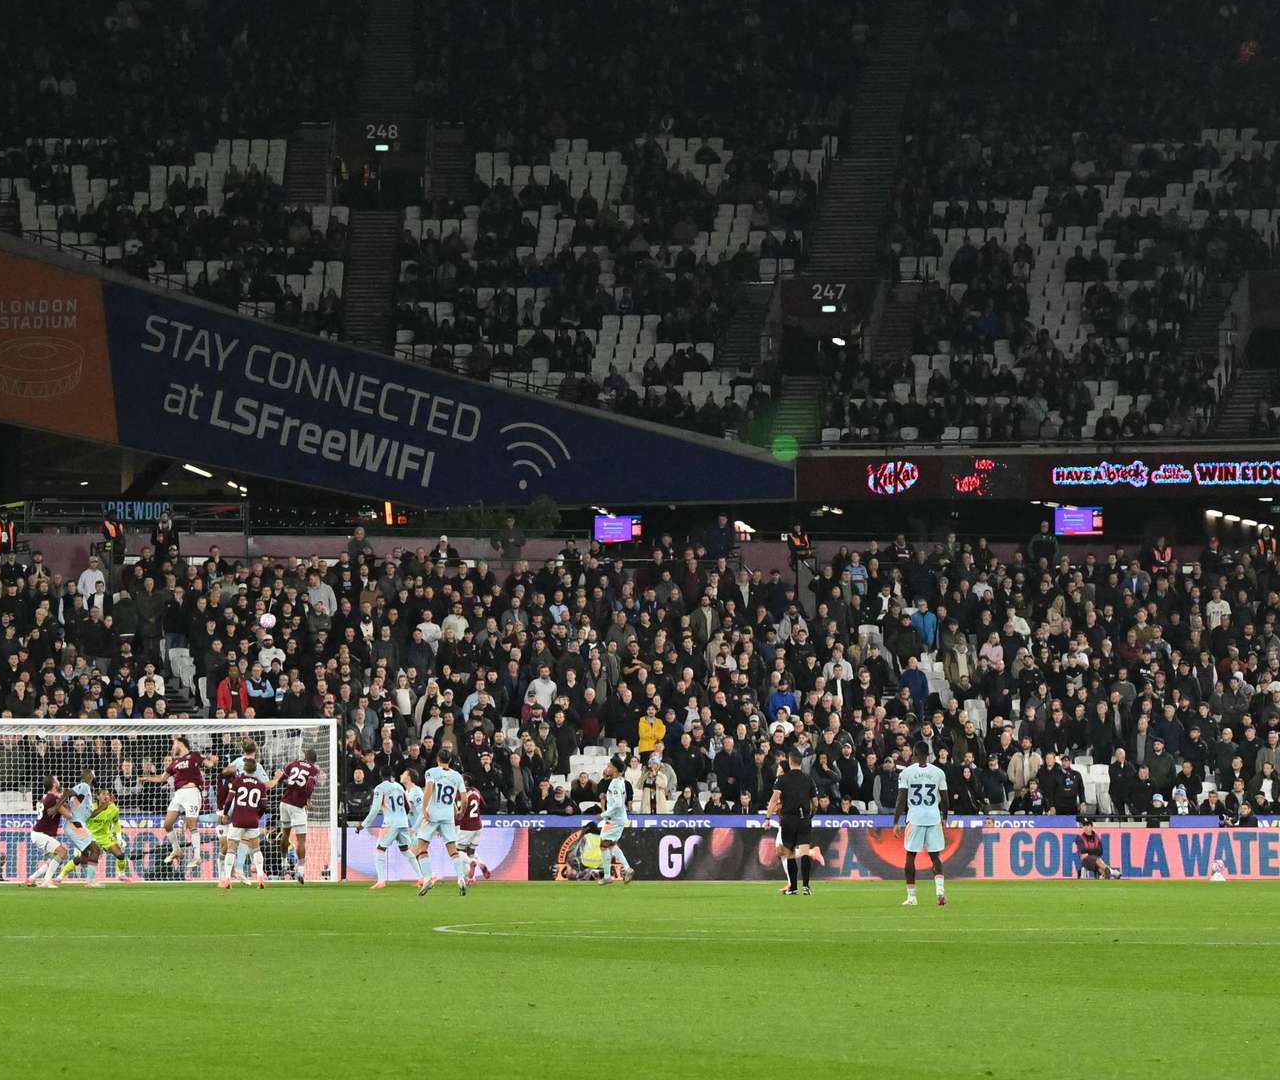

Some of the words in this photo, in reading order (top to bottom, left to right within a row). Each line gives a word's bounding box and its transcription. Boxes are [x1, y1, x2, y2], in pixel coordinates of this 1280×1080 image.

[365, 123, 398, 140] 248
[811, 283, 847, 301] 247
[0, 299, 78, 314] LONDON
[0, 315, 78, 330] STADIUM
[140, 315, 240, 371] STAY
[244, 344, 482, 442] CONNECTED
[163, 382, 204, 420] at
[209, 389, 436, 488] LSFreeWIFI
[866, 461, 919, 494] KitKat
[1057, 469, 1092, 482] HAVE
[1104, 464, 1147, 483] break
[1198, 463, 1239, 484] WIN
[287, 766, 310, 787] 25
[236, 786, 262, 808] 20
[436, 783, 455, 806] 18
[909, 783, 937, 807] 33
[188, 805, 199, 815] 39
[495, 819, 546, 828] SPORTS
[660, 819, 711, 828] SPORTS
[824, 819, 874, 828] SPORTS
[993, 820, 1036, 828] PORTS
